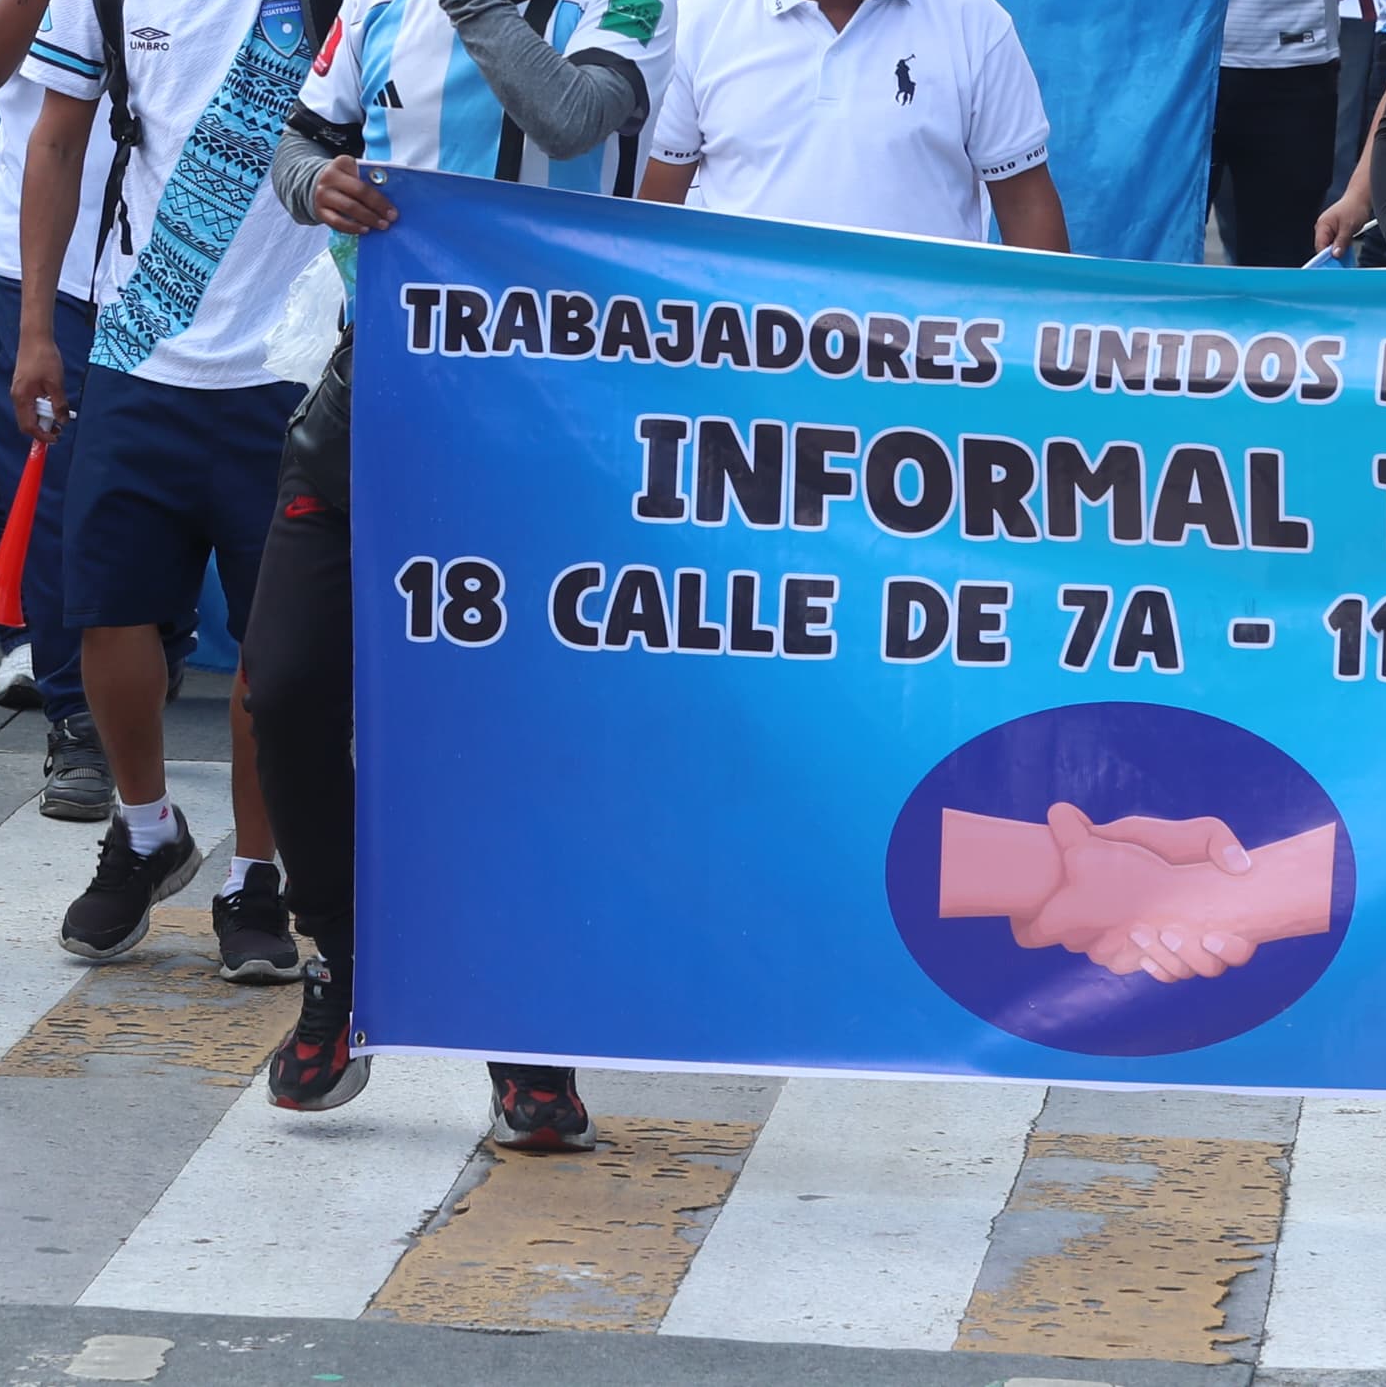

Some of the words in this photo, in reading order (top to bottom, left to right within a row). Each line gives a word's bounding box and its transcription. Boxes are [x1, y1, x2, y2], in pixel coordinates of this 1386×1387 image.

[130, 41, 170, 52] UMBRO
[981, 161, 1017, 175] POLO
[404, 286, 1000, 385] TRABAJADORES
[1038, 325, 1343, 402] UNIDOS
[637, 418, 1311, 551] INFORMAL
[398, 558, 504, 645] 18
[553, 564, 836, 656] CALLE
[884, 580, 1009, 662] DE
[1061, 586, 1181, 671] 7A
